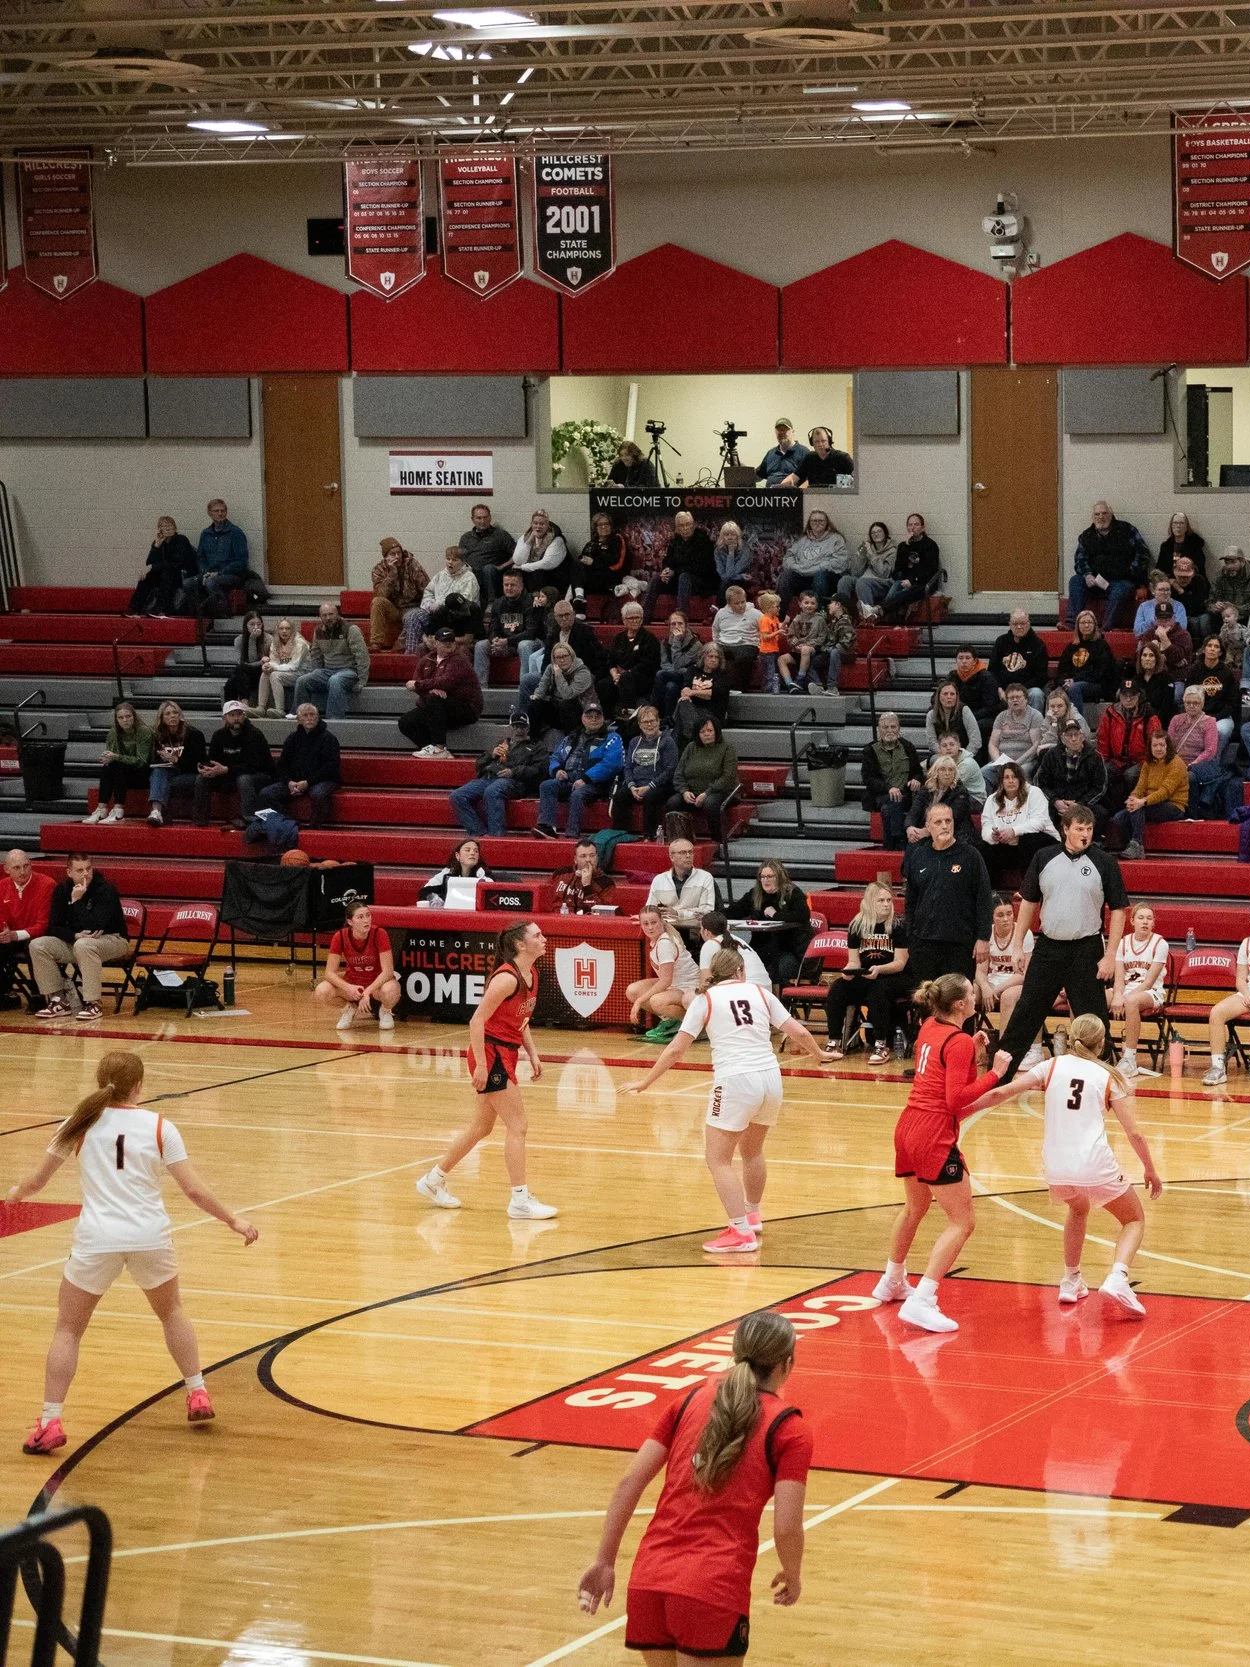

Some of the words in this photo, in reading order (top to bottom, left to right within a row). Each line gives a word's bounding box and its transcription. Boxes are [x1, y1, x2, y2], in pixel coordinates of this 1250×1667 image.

[542, 154, 602, 164] HILLCREST
[1215, 152, 1248, 160] CHAMPIONS
[542, 167, 604, 181] COMETS
[1216, 176, 1248, 184] RUNNER-UP
[551, 187, 594, 196] FOOTBALL
[1216, 200, 1248, 208] CHAMPIONS
[546, 205, 600, 234] 2001
[560, 240, 588, 248] STATE
[546, 250, 602, 259] CHAMPIONS
[400, 471, 432, 486] HOME
[436, 471, 484, 486] SEATING
[597, 496, 661, 507] WELCOME
[664, 496, 682, 507] TO
[684, 495, 732, 508] COMET
[736, 496, 798, 508] COUNTRY
[498, 896, 522, 906] POSS.
[176, 909, 213, 922] HILLCREST
[410, 939, 445, 948] HOME
[454, 941, 470, 949] OF
[480, 942, 494, 950] TH
[814, 938, 848, 950] HILLCRES
[402, 950, 496, 971] HILLCRES
[1188, 956, 1232, 968] HILLCREST
[574, 958, 598, 990] H
[730, 1000, 754, 1026] 13
[918, 1043, 932, 1075] 11
[1067, 1078, 1084, 1110] 3
[712, 1086, 722, 1118] ROCKETS
[116, 1134, 125, 1170] 1
